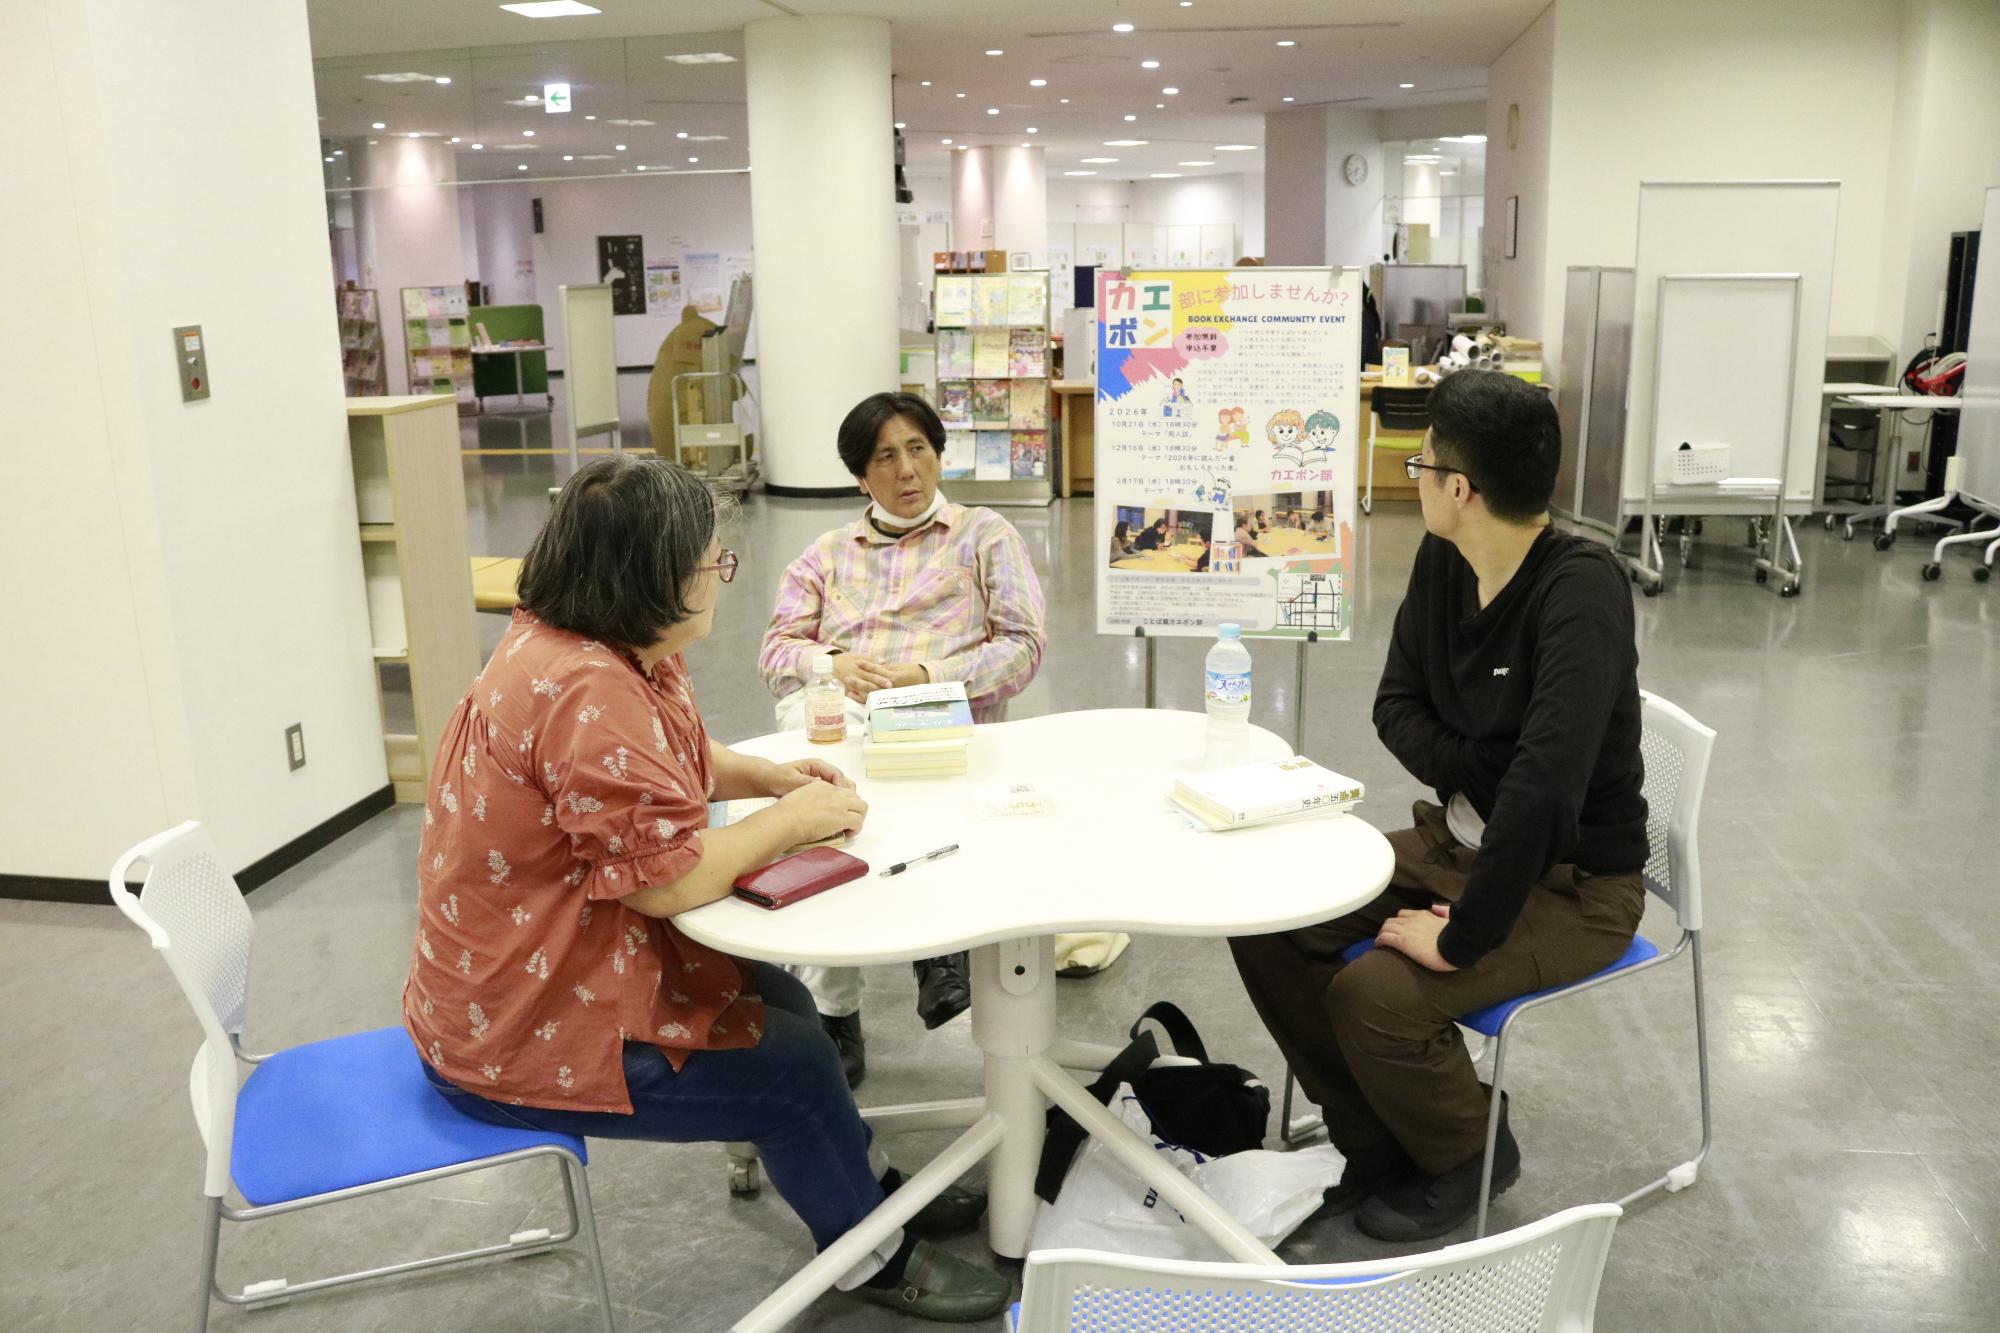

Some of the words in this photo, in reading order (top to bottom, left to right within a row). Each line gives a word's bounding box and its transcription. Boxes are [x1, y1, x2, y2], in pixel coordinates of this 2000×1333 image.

[1188, 315, 1212, 323] BOOK
[1214, 315, 1258, 323] EXCHANGE
[1261, 315, 1316, 323] COMMUNITY
[1319, 315, 1346, 323] EVENT
[1186, 344, 1217, 352] 申込不要
